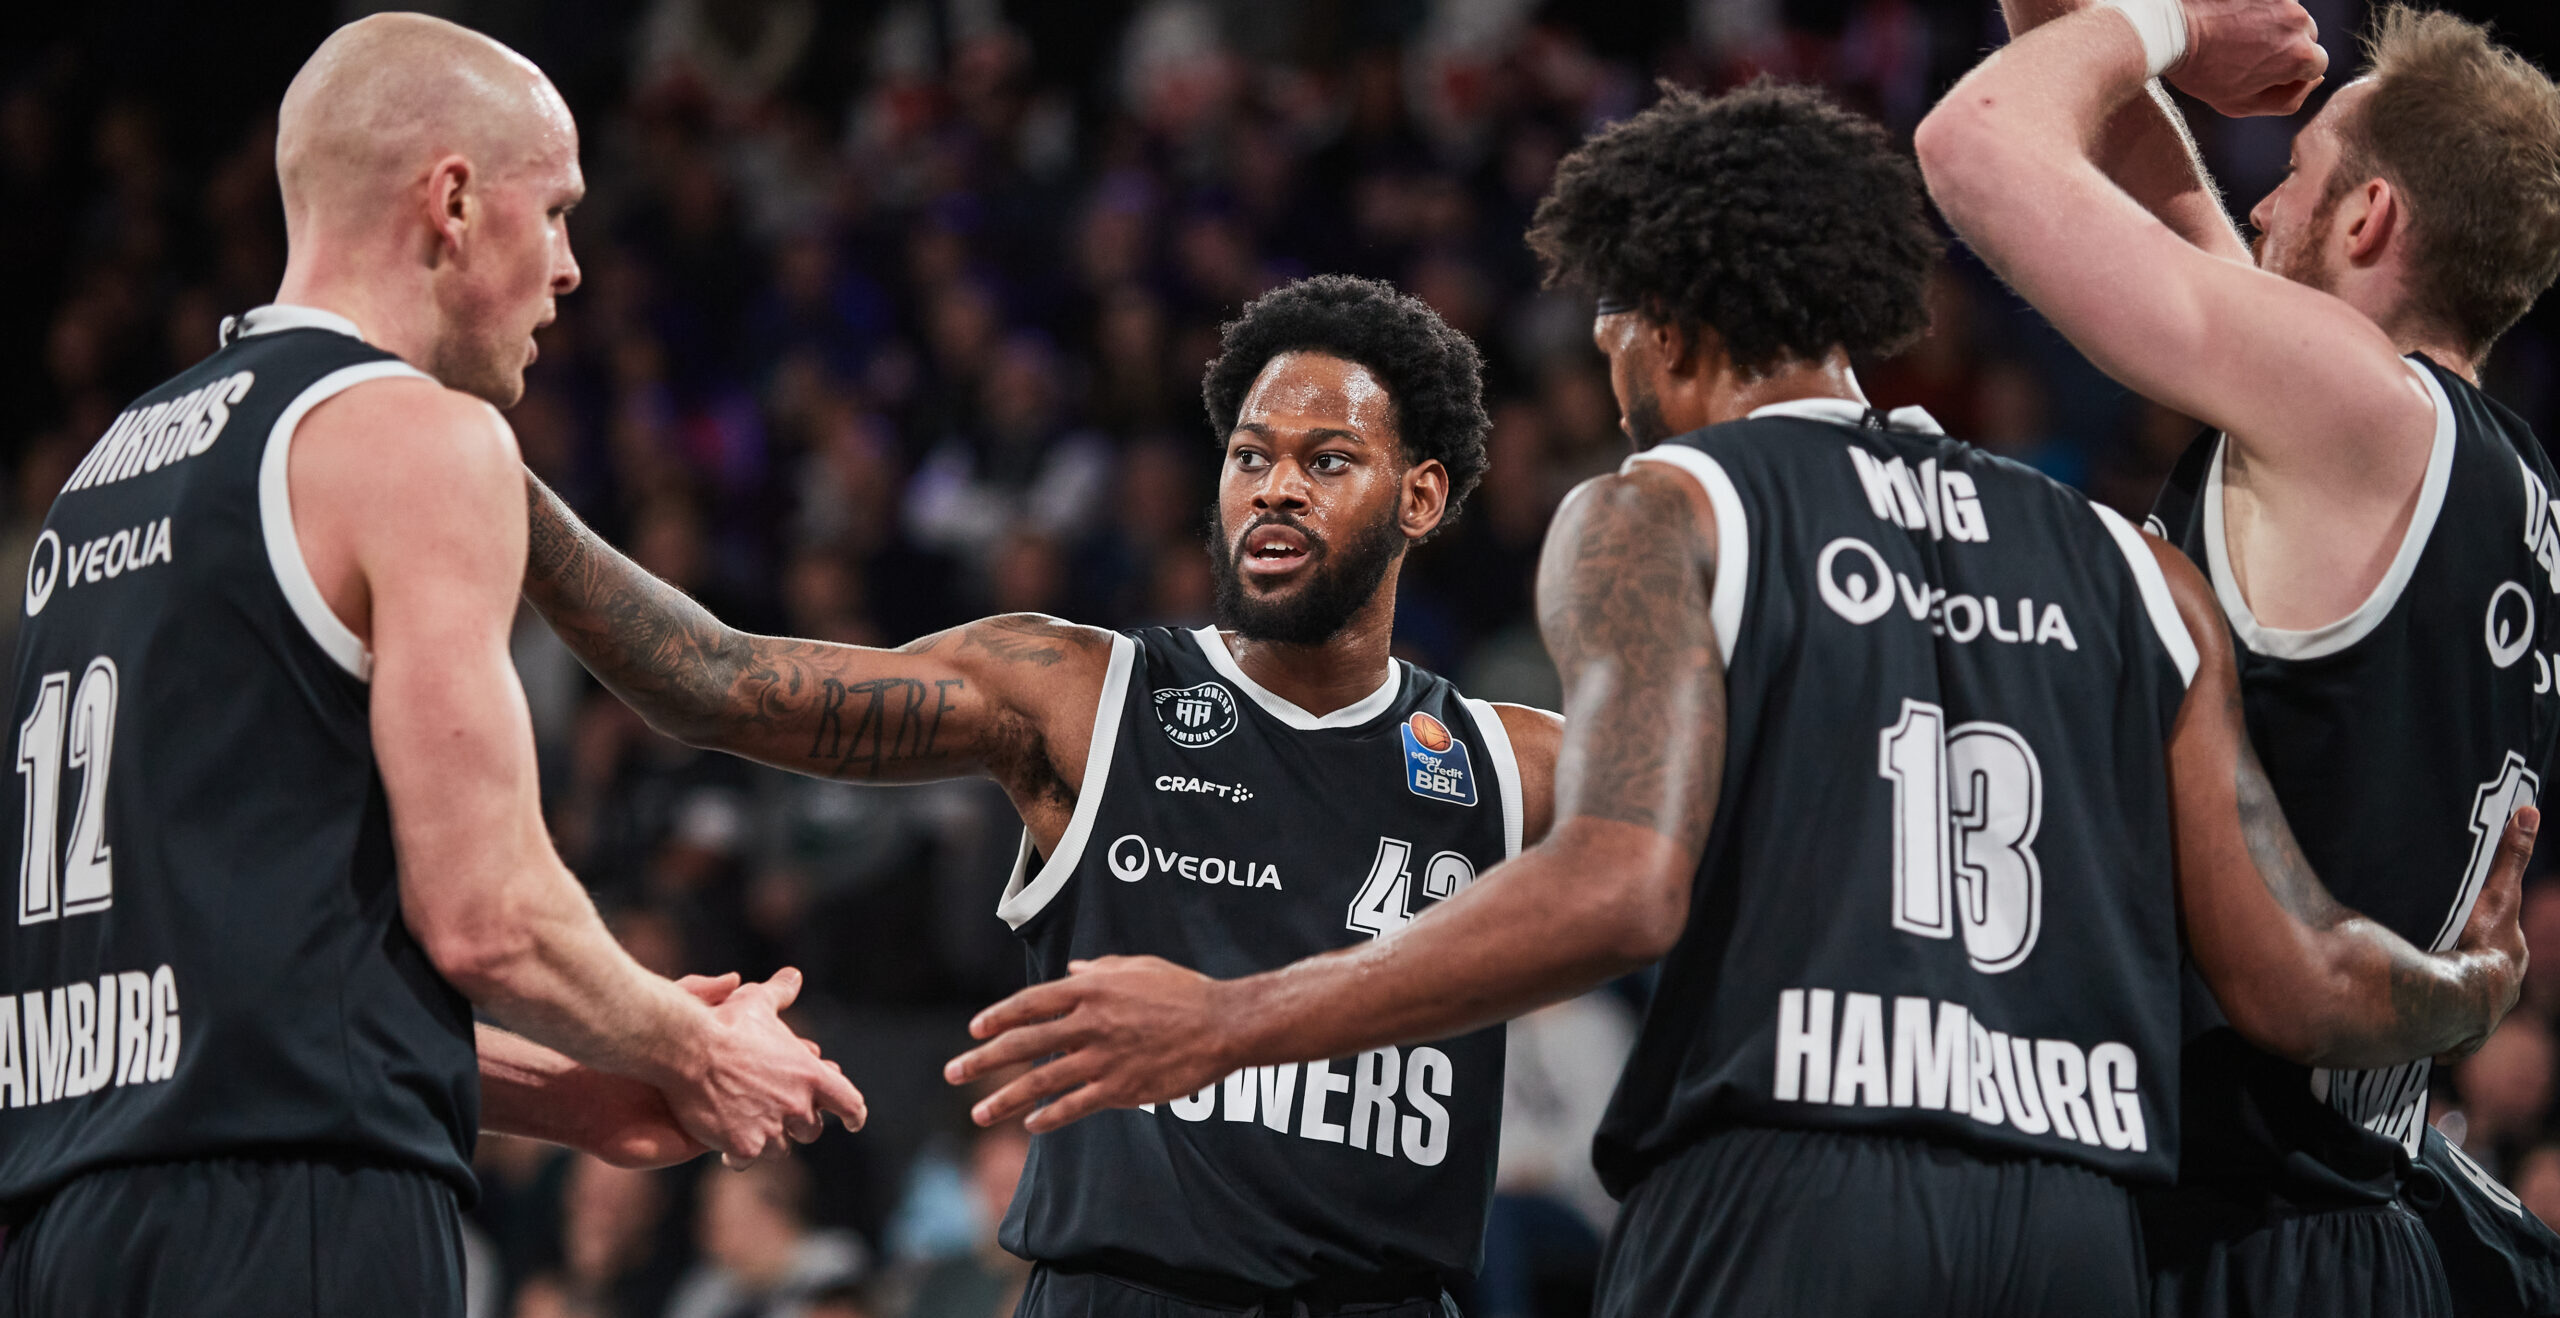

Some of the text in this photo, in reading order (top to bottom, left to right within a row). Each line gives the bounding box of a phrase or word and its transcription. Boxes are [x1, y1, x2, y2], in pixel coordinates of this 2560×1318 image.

[67, 516, 172, 588] VEOLIA
[1897, 572, 2078, 652] VEOLIA
[1164, 724, 1217, 742] HAMBURG
[1198, 687, 1232, 714] TOWERS
[16, 655, 118, 926] 12
[1155, 775, 1232, 798] CRAFT
[1415, 769, 1466, 798] BBL
[1153, 847, 1283, 891] VEOLIA
[1878, 698, 2043, 975] 13
[0, 963, 181, 1110] AMBURG
[1774, 988, 2148, 1153] HAMBURG
[1138, 1044, 1453, 1167] WERS
